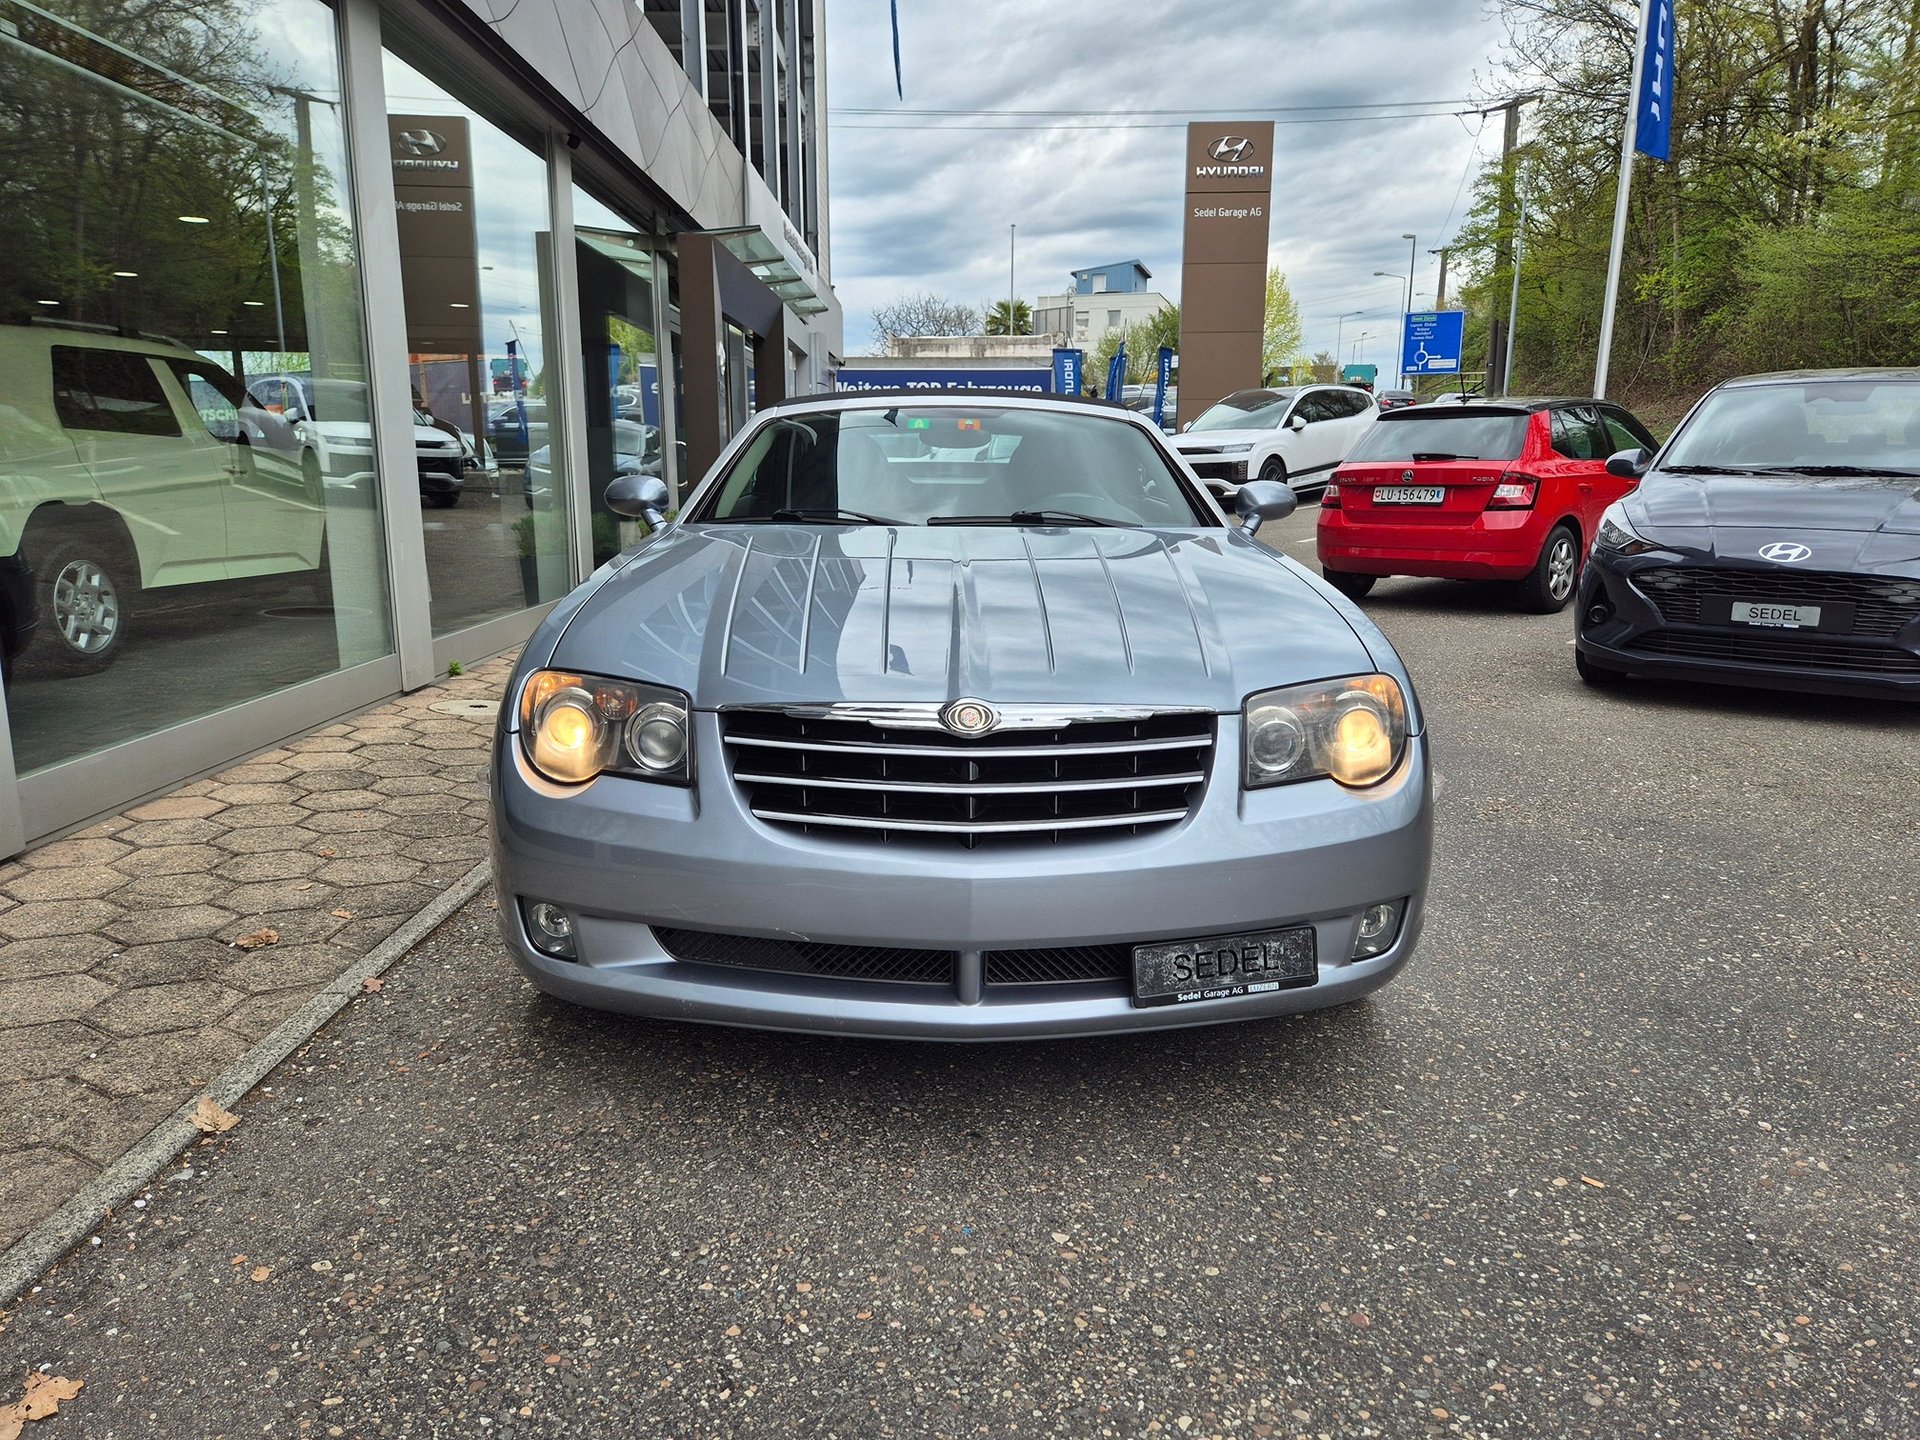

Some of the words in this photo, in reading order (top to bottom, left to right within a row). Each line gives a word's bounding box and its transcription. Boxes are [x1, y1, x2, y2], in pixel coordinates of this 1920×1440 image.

[1196, 166, 1264, 177] HYUNDAI
[1194, 207, 1217, 217] Sedel
[1218, 207, 1248, 219] Garage
[1249, 207, 1262, 217] AG
[1749, 607, 1801, 621] SEDEL
[1173, 944, 1279, 982] SEDEL
[1177, 991, 1201, 1002] Sedel
[1203, 988, 1230, 999] Garage
[1231, 986, 1244, 995] AG
